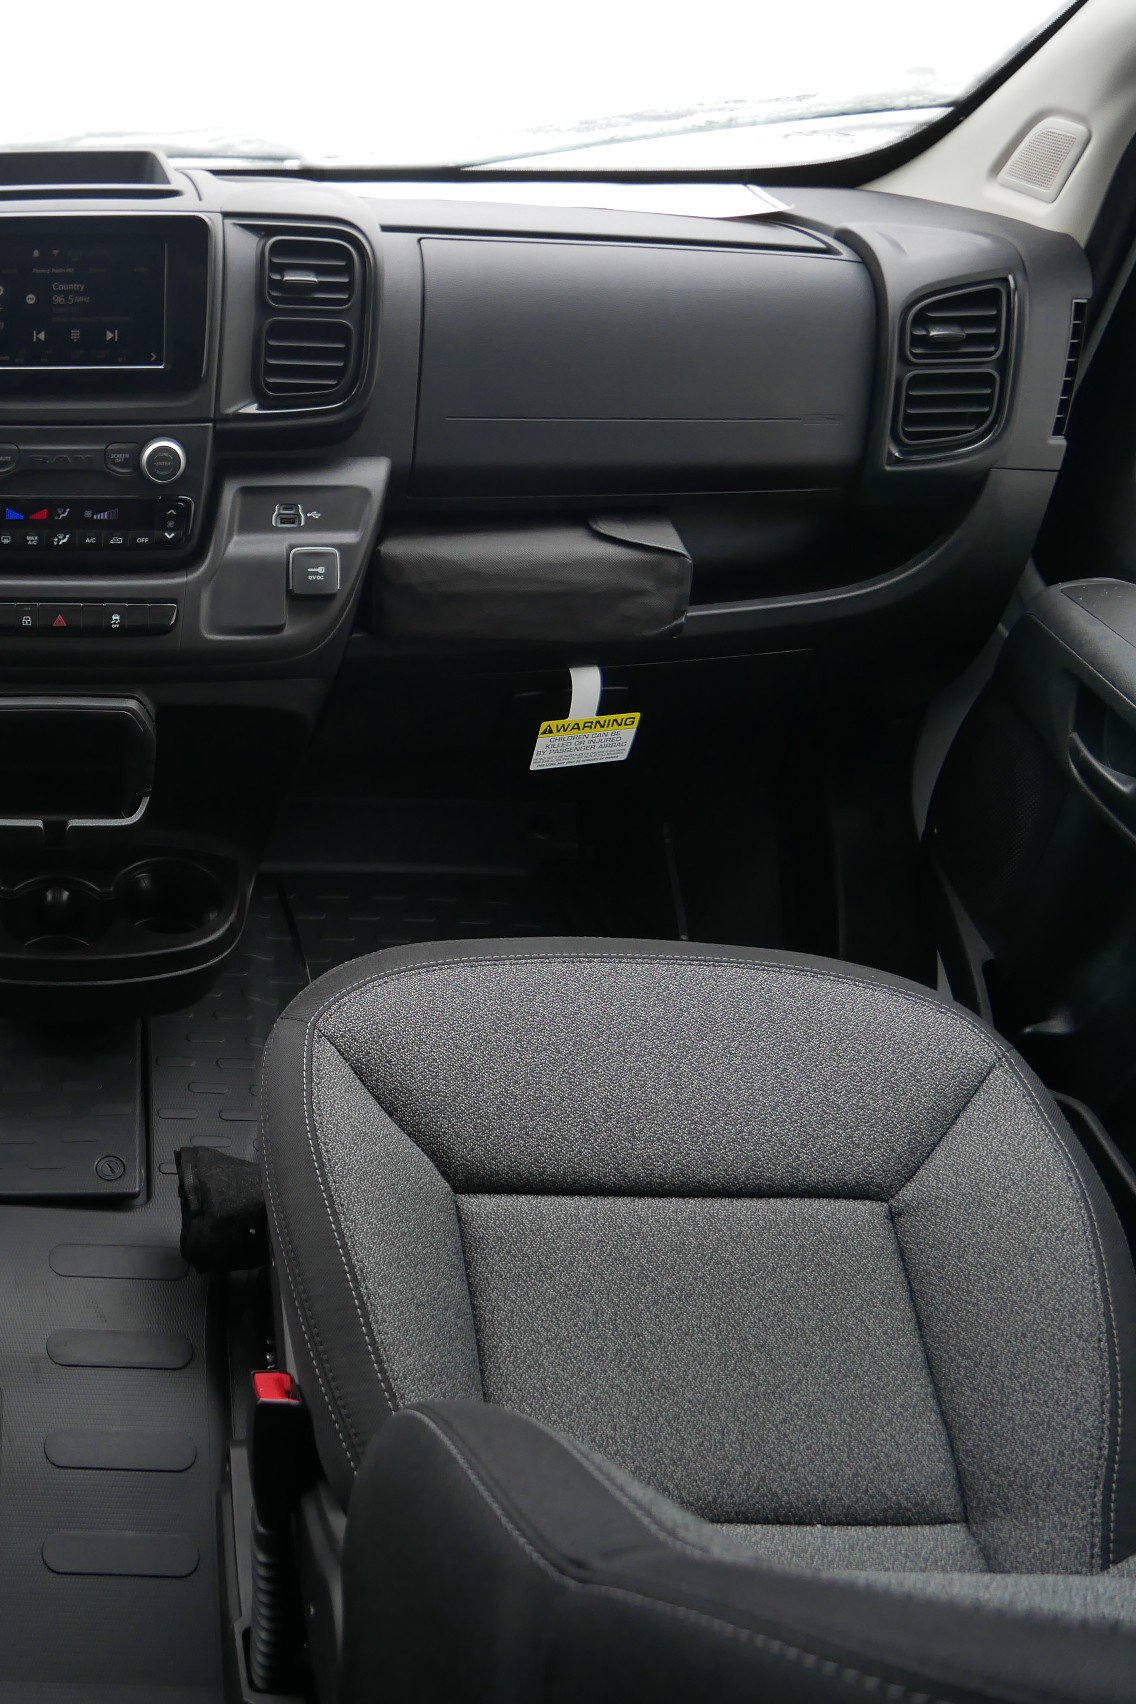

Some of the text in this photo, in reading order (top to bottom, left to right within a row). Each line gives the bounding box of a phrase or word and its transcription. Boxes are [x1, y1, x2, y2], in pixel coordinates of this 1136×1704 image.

[52, 282, 85, 292] Country
[556, 717, 636, 733] WARNING
[545, 741, 573, 750] KILLED
[588, 736, 622, 745] INJURED
[549, 733, 590, 743] CHILDREN
[536, 749, 548, 757] BY
[549, 745, 596, 755] PASSENGER
[598, 741, 628, 750] AIRBAG
